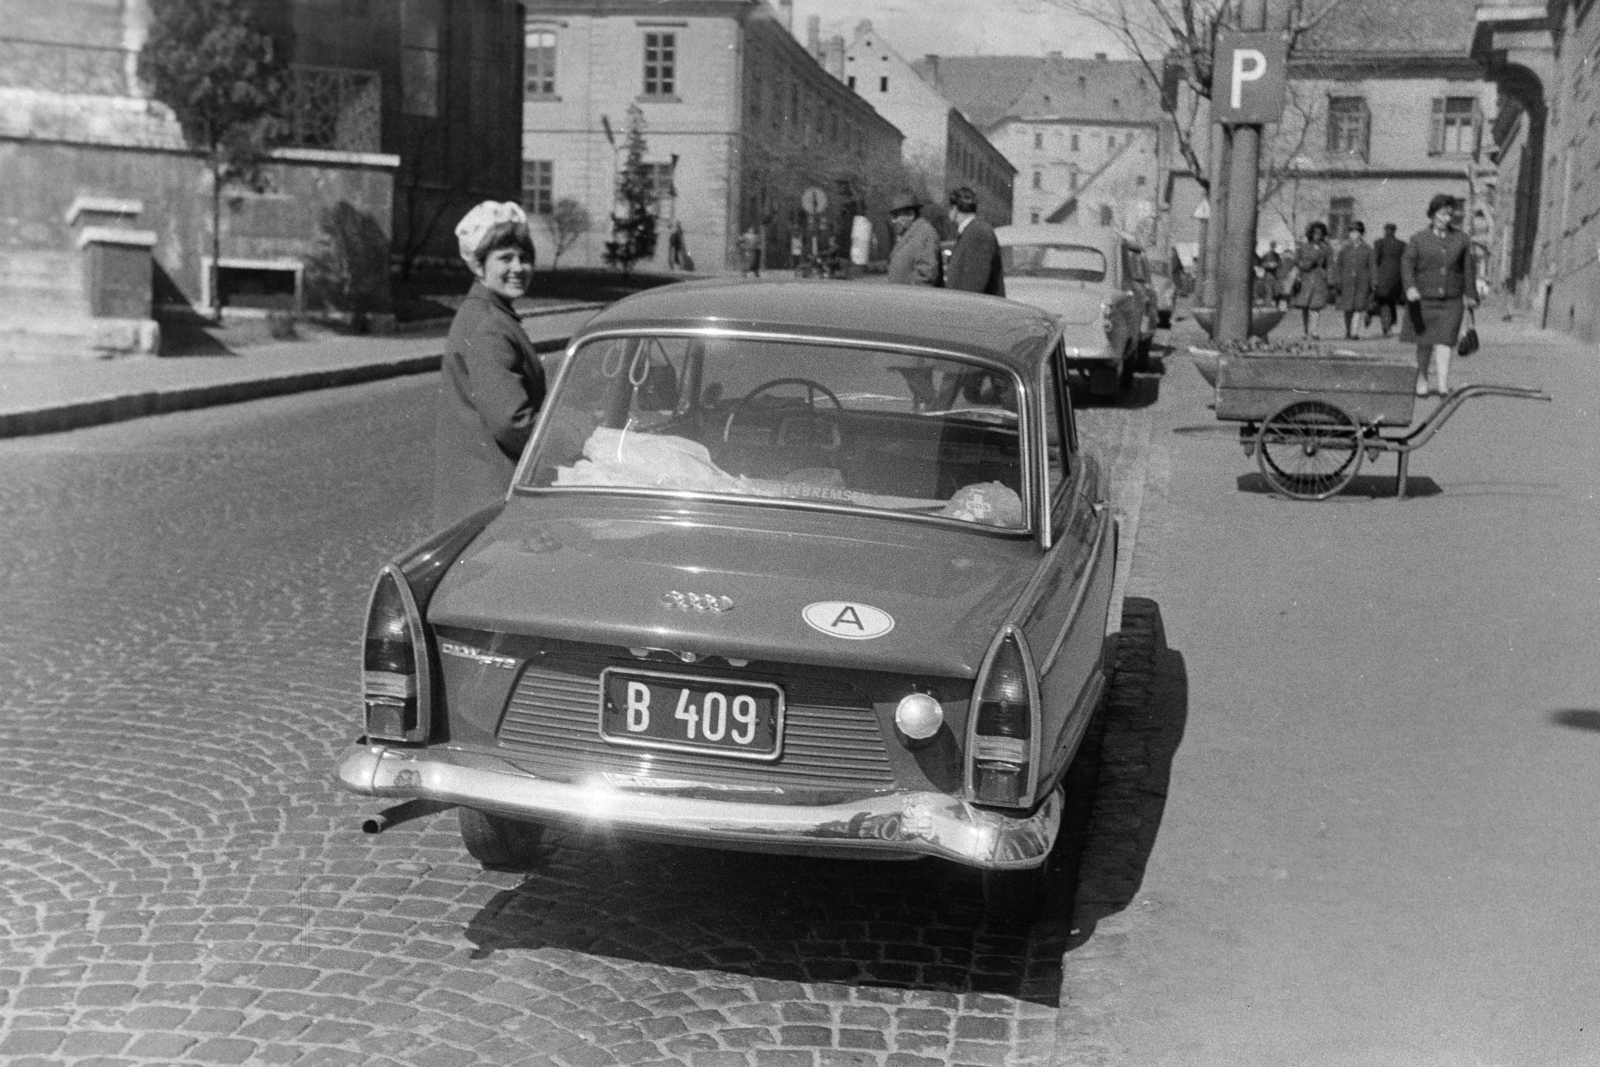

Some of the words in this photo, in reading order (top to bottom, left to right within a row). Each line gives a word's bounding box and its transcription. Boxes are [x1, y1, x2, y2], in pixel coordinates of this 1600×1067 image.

[1230, 48, 1267, 109] P
[831, 605, 865, 631] A
[626, 681, 650, 732] B
[674, 688, 757, 744] 409
